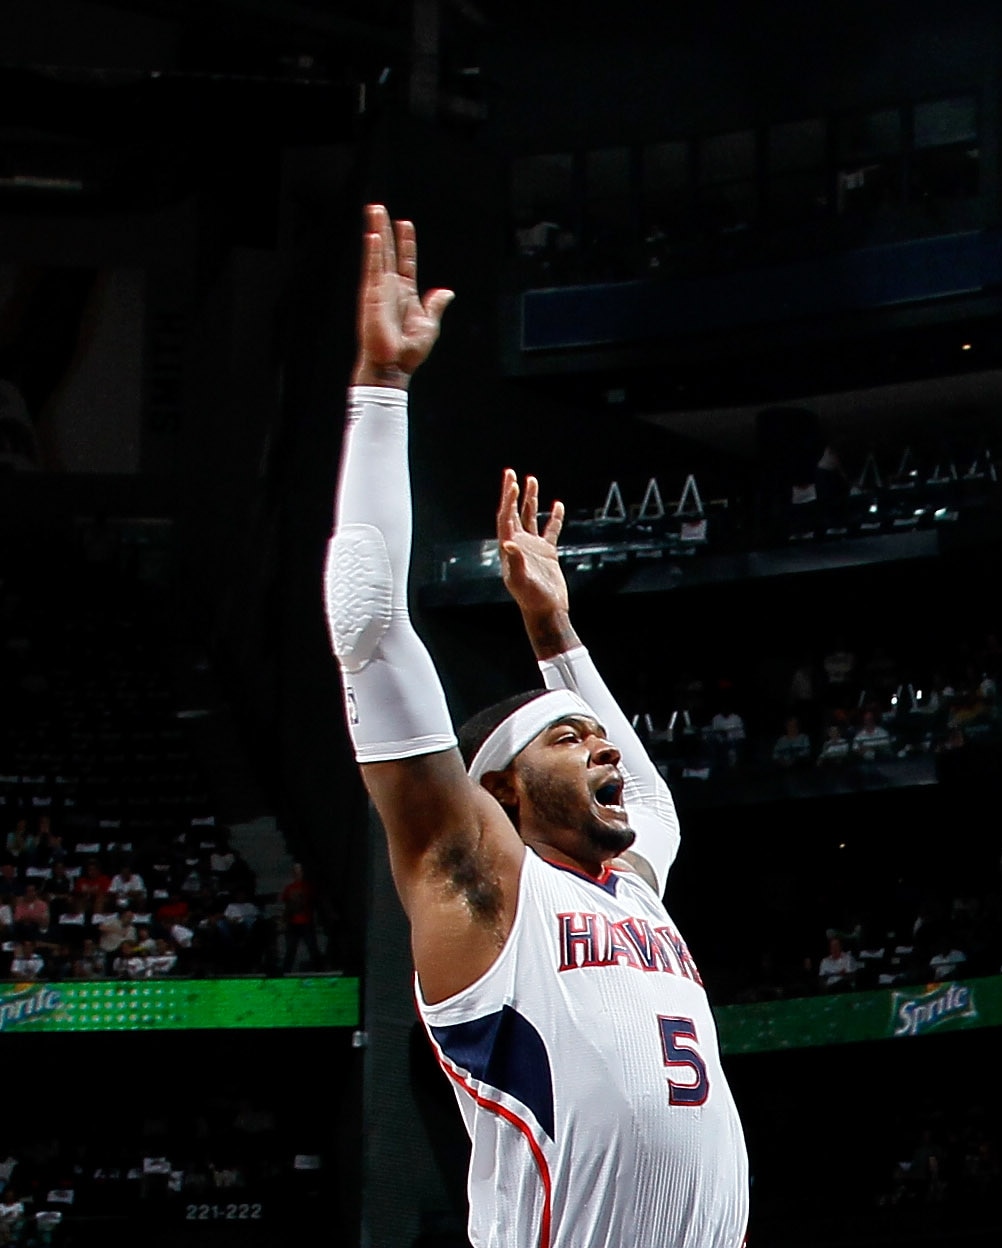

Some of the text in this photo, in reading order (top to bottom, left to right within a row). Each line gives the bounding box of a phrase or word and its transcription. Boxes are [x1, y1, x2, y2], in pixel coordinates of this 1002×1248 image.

[895, 983, 968, 1036] Sprite
[656, 1014, 710, 1107] 5
[185, 1202, 264, 1221] 221-222
